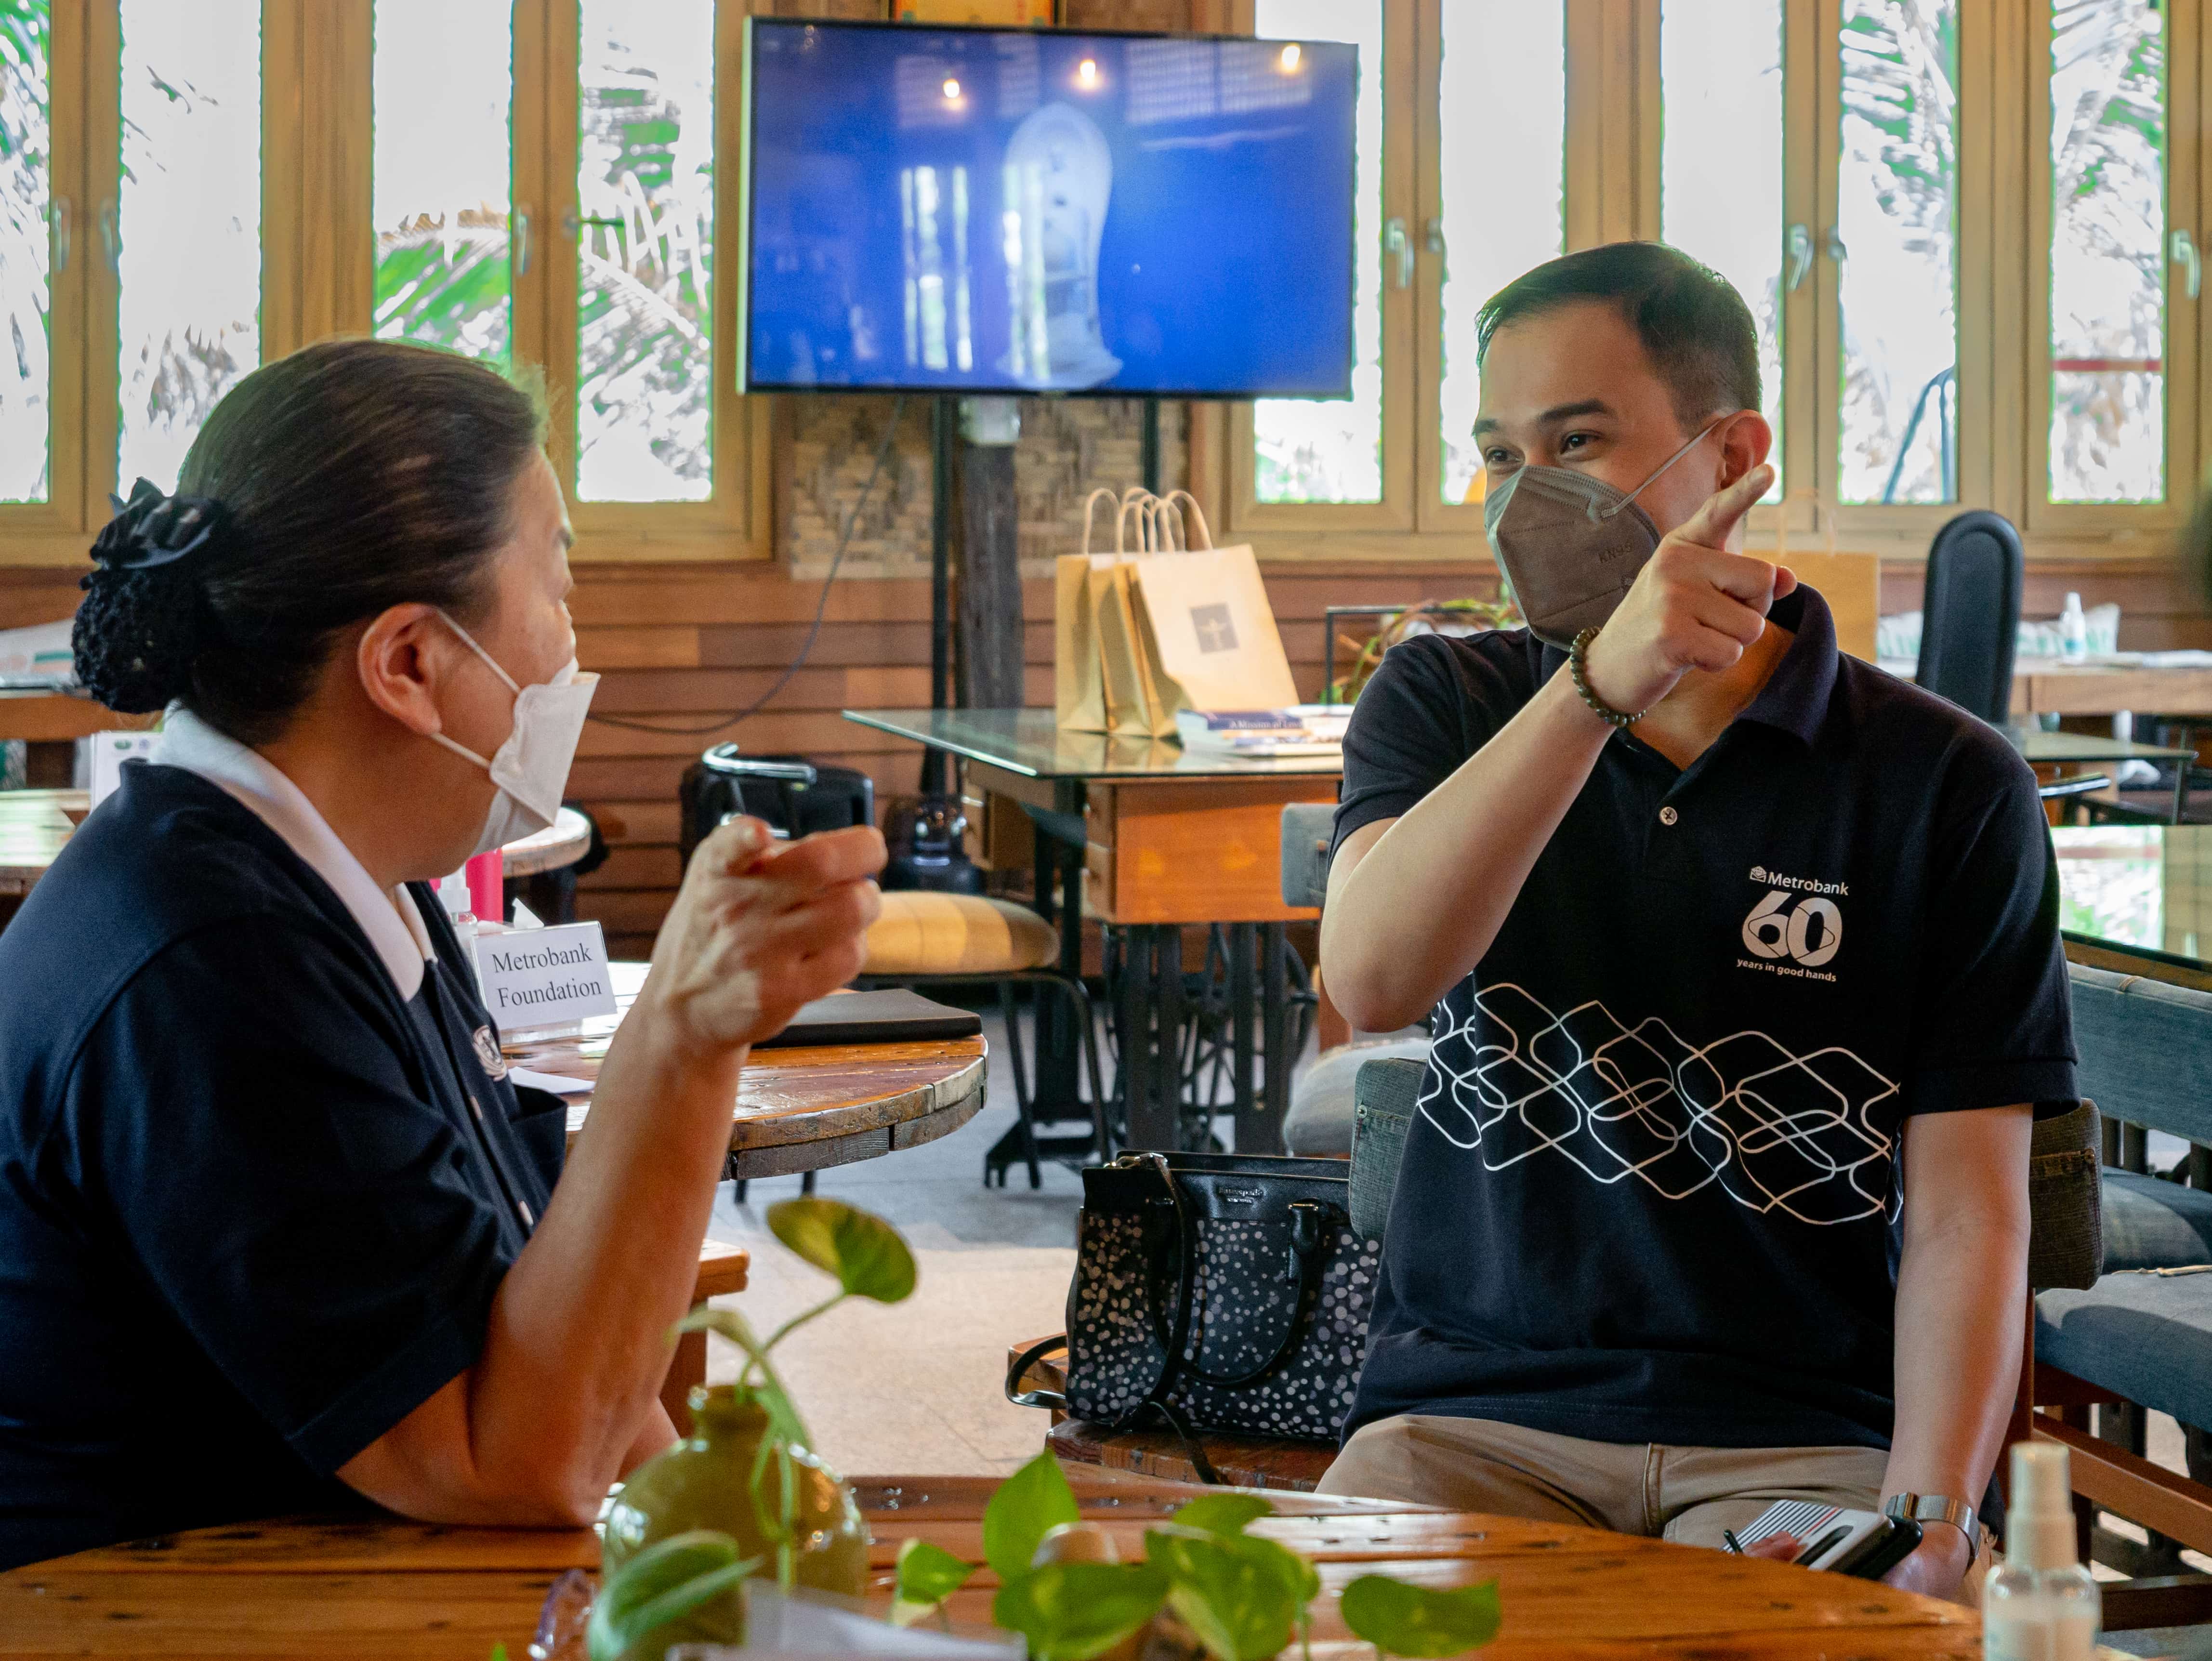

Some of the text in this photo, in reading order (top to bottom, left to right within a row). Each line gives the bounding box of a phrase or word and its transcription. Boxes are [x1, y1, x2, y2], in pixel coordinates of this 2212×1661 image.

[1239, 720, 1271, 729] Mission
[1767, 871, 1849, 896] Metrobank
[1742, 890, 1843, 966] 60
[491, 942, 593, 973] Metrobank
[1737, 959, 1836, 982] years in good hands
[497, 977, 602, 1007] Foundation
